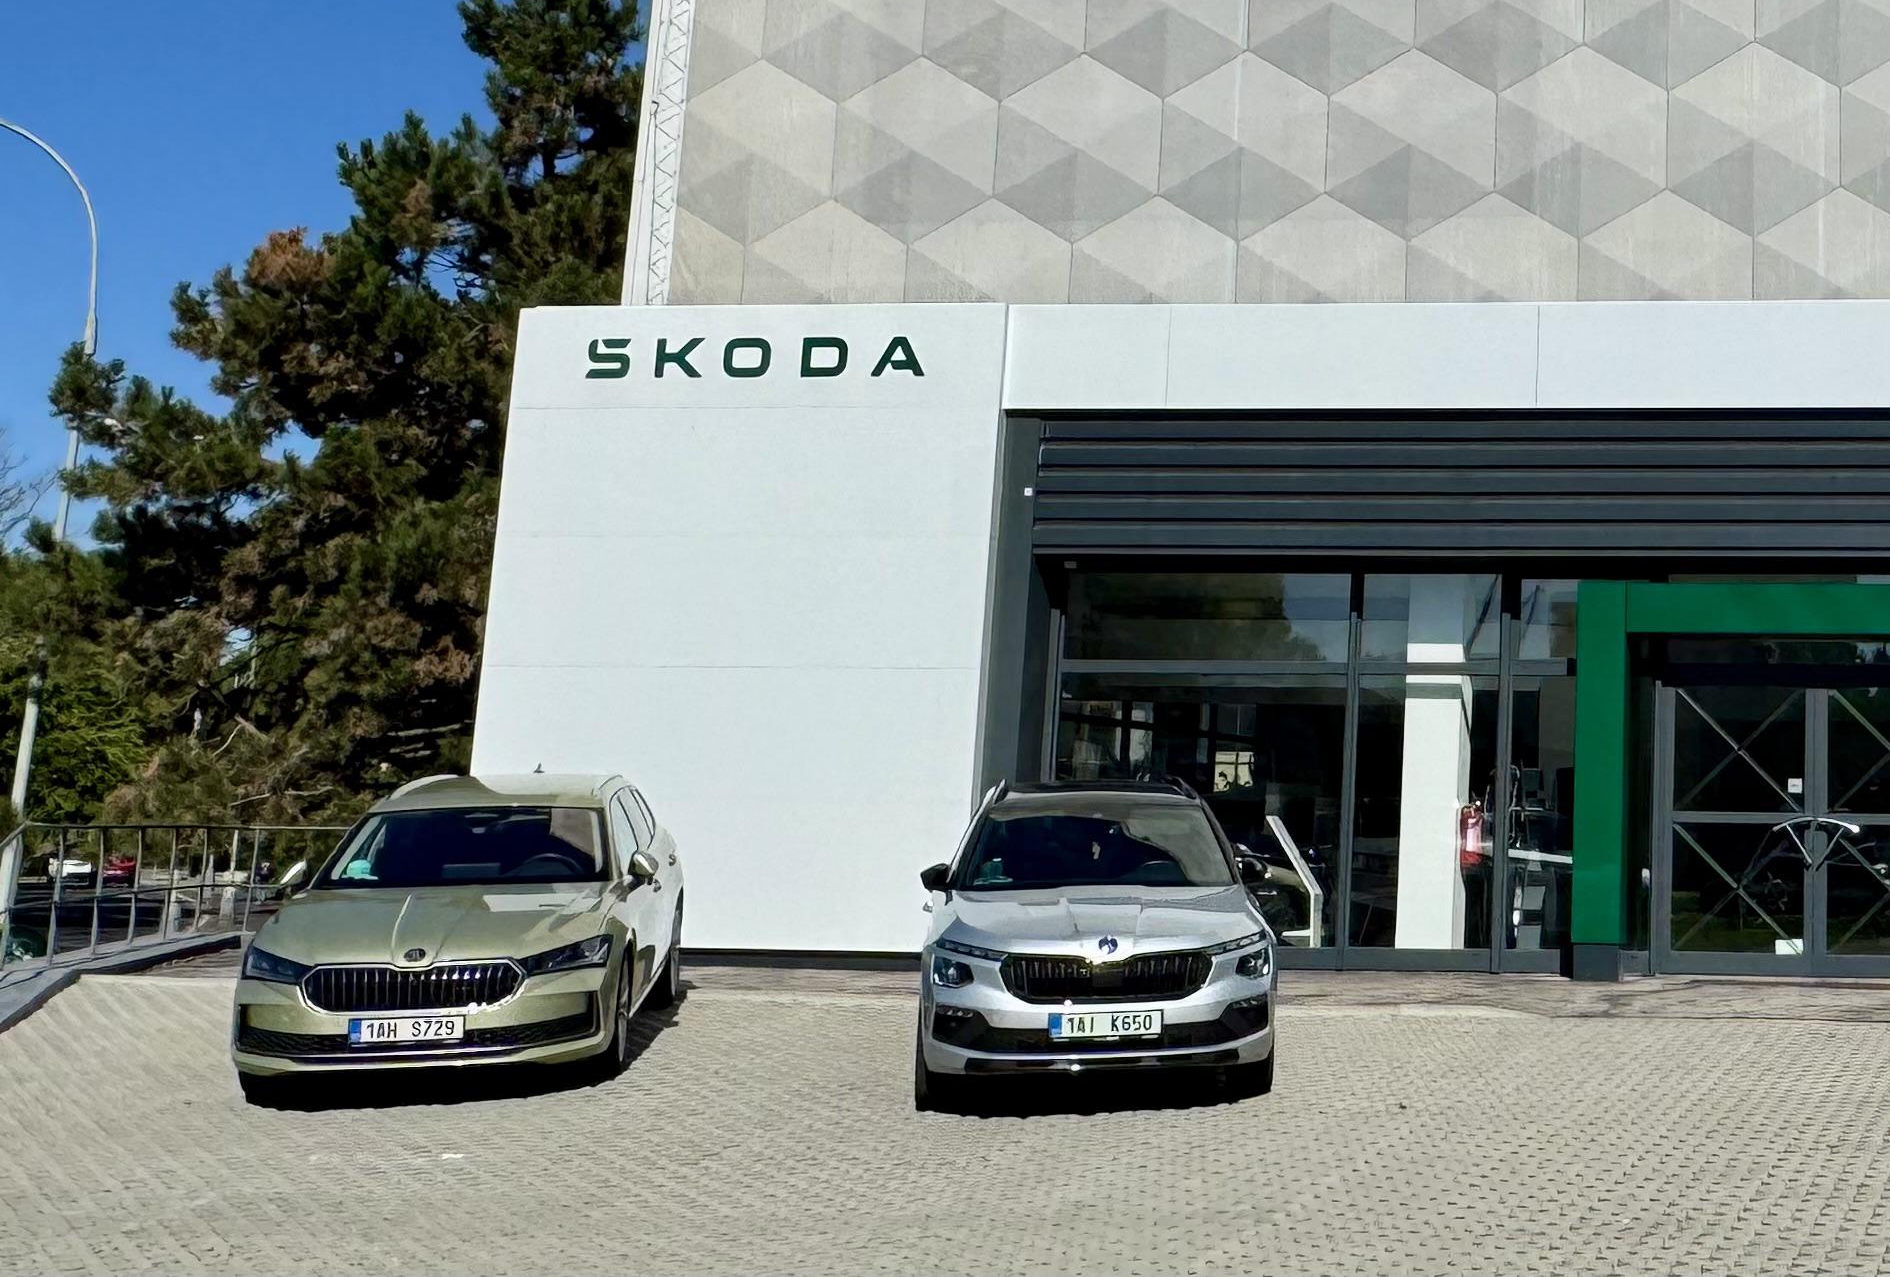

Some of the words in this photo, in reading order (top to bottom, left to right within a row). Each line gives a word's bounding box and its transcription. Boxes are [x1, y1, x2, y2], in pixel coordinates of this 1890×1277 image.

[366, 1021, 398, 1039] 1AH
[411, 1020, 455, 1038] S729
[1110, 1014, 1153, 1033] K650
